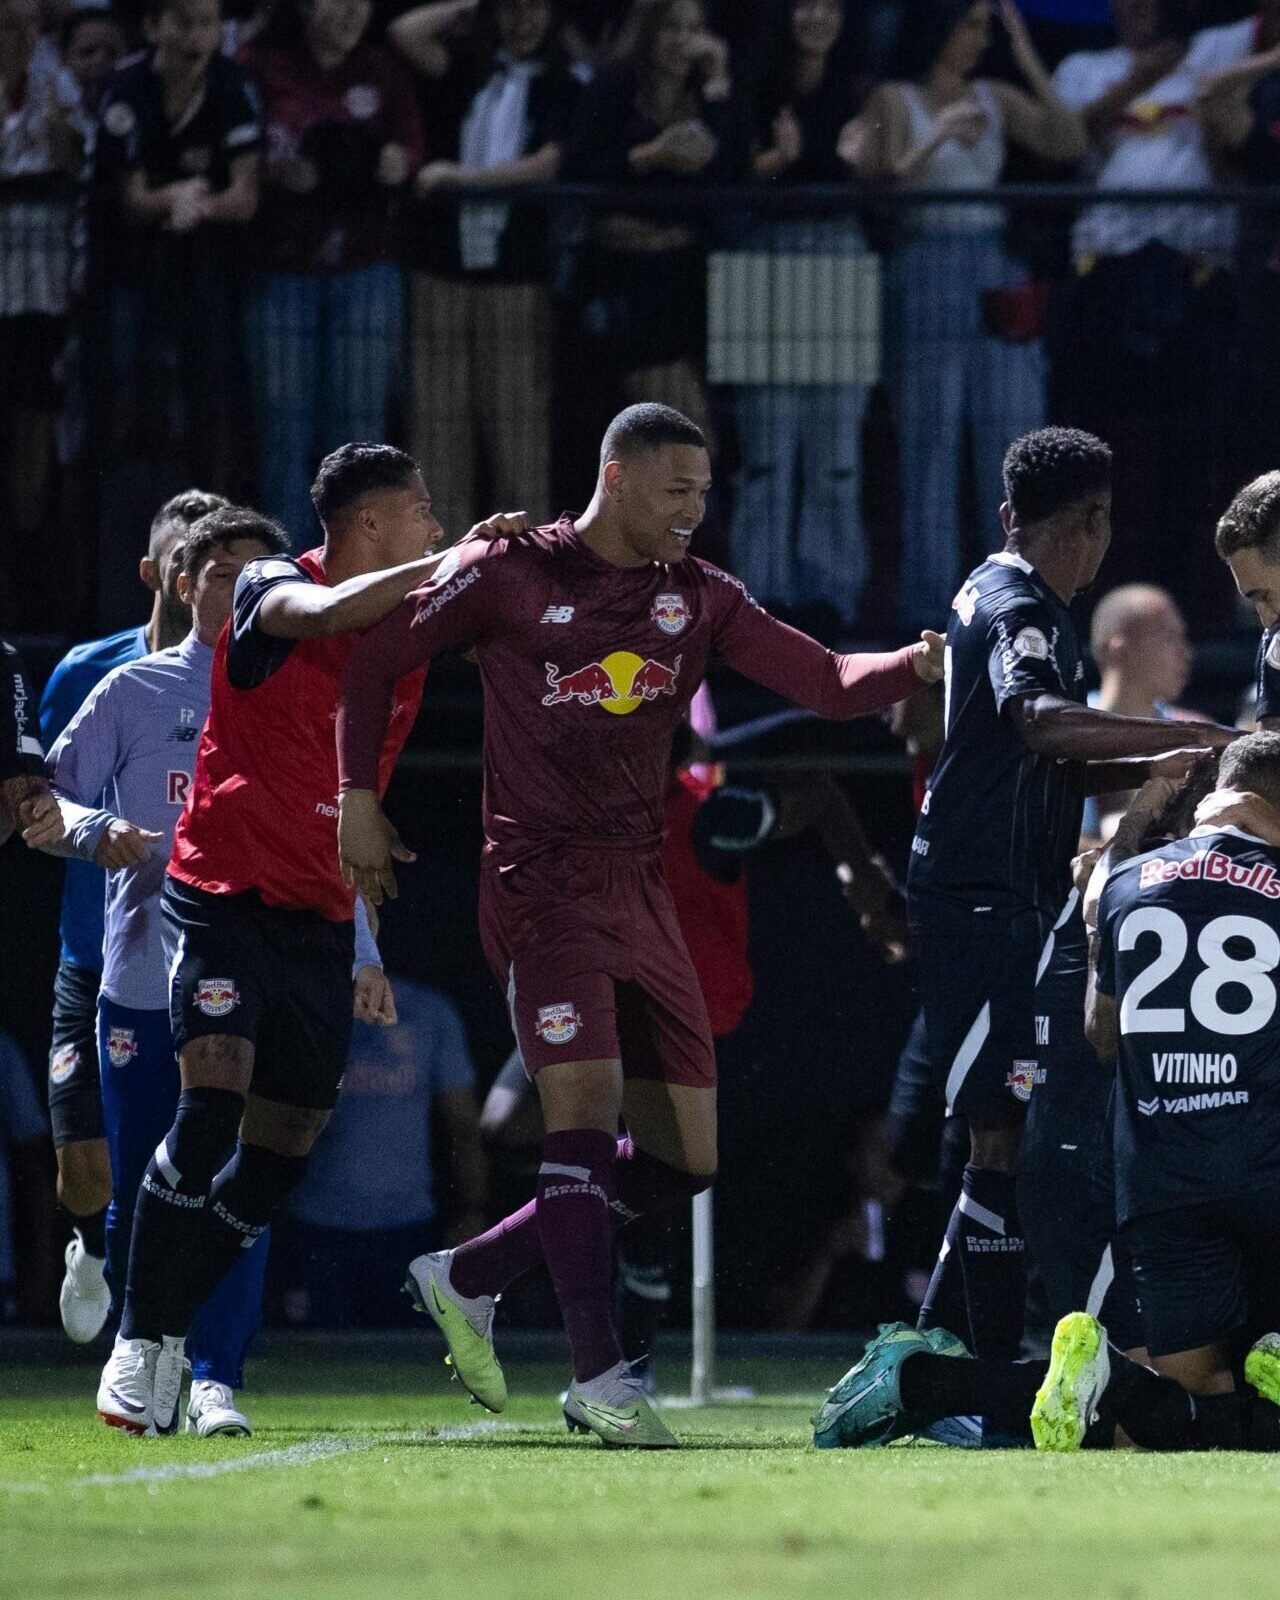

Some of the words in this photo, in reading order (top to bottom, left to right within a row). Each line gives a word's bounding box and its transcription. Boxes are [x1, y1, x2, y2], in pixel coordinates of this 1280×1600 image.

[417, 565, 483, 624] mrjack.bet
[1152, 1052, 1238, 1084] VITINHO
[1162, 1091, 1249, 1114] YANMAR
